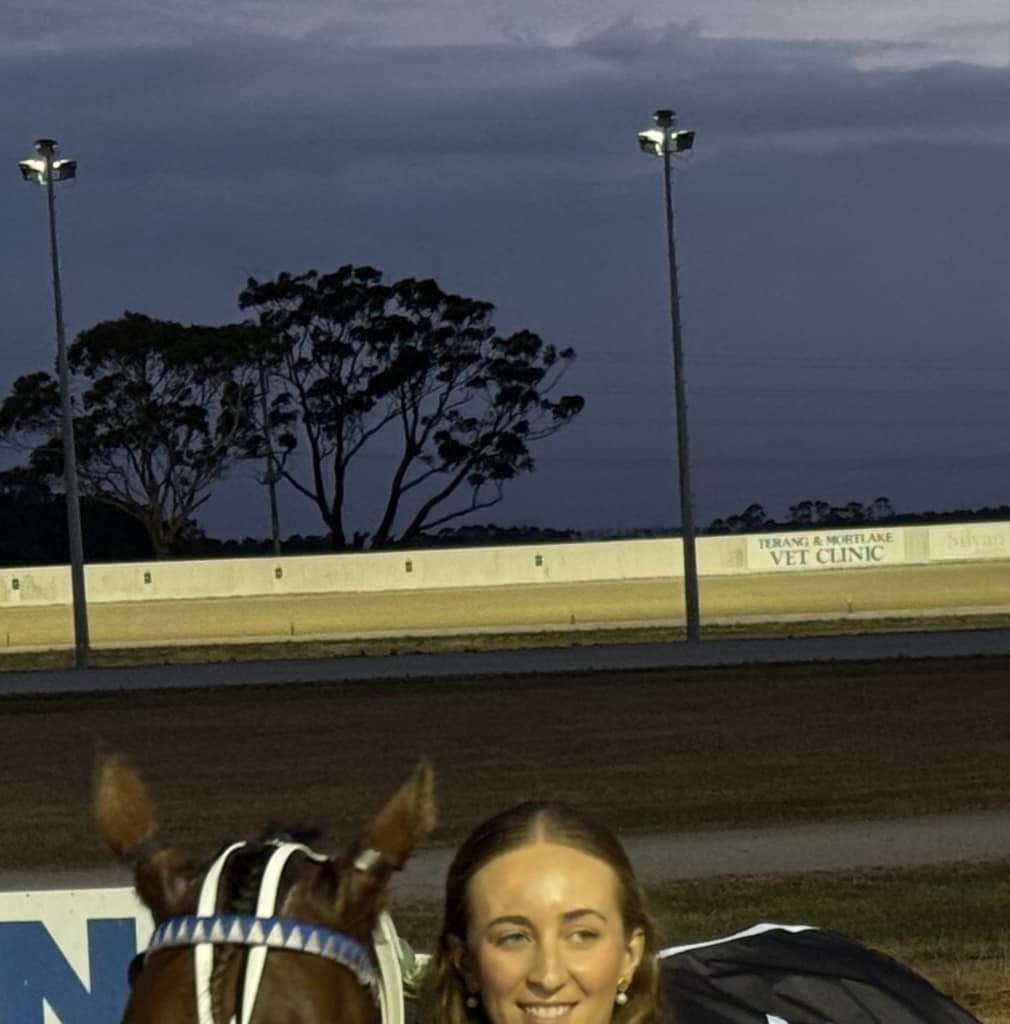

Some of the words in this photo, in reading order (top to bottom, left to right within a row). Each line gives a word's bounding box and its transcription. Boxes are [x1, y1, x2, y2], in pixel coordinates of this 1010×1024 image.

[759, 537, 809, 549] TERANG
[814, 535, 823, 546] &
[827, 532, 895, 545] MORTLAKE
[770, 549, 809, 566] VET
[816, 545, 885, 564] CLINIC
